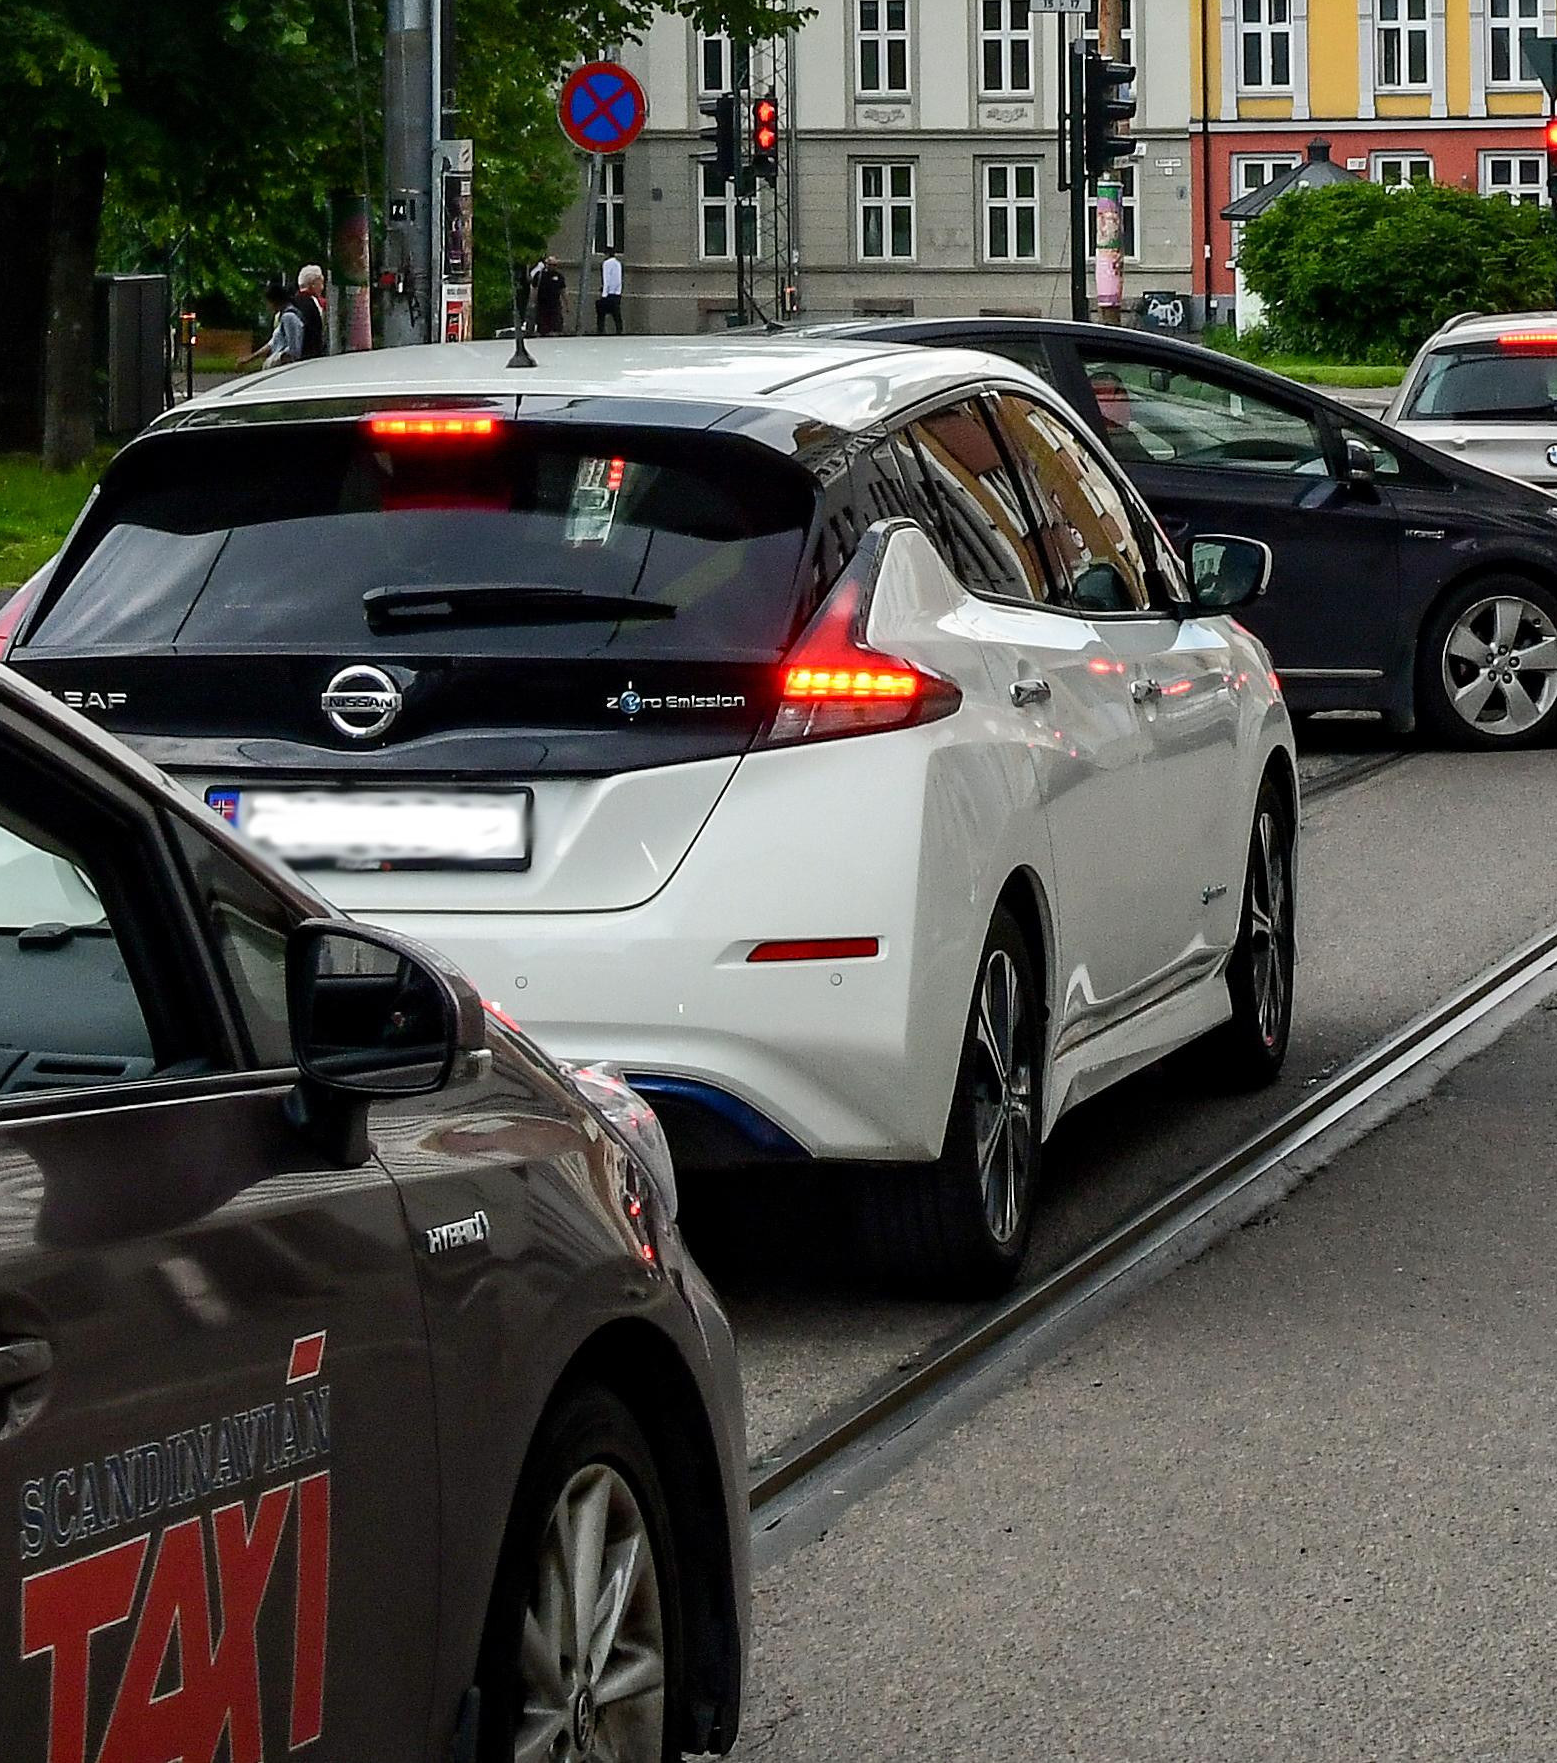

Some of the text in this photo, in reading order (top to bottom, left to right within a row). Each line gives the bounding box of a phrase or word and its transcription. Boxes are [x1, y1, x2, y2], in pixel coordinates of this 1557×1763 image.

[1070, 0, 1080, 9] 17
[45, 690, 128, 710] EAF
[329, 696, 393, 708] NISSAN
[20, 1384, 331, 1561] SCANDINAVIAN
